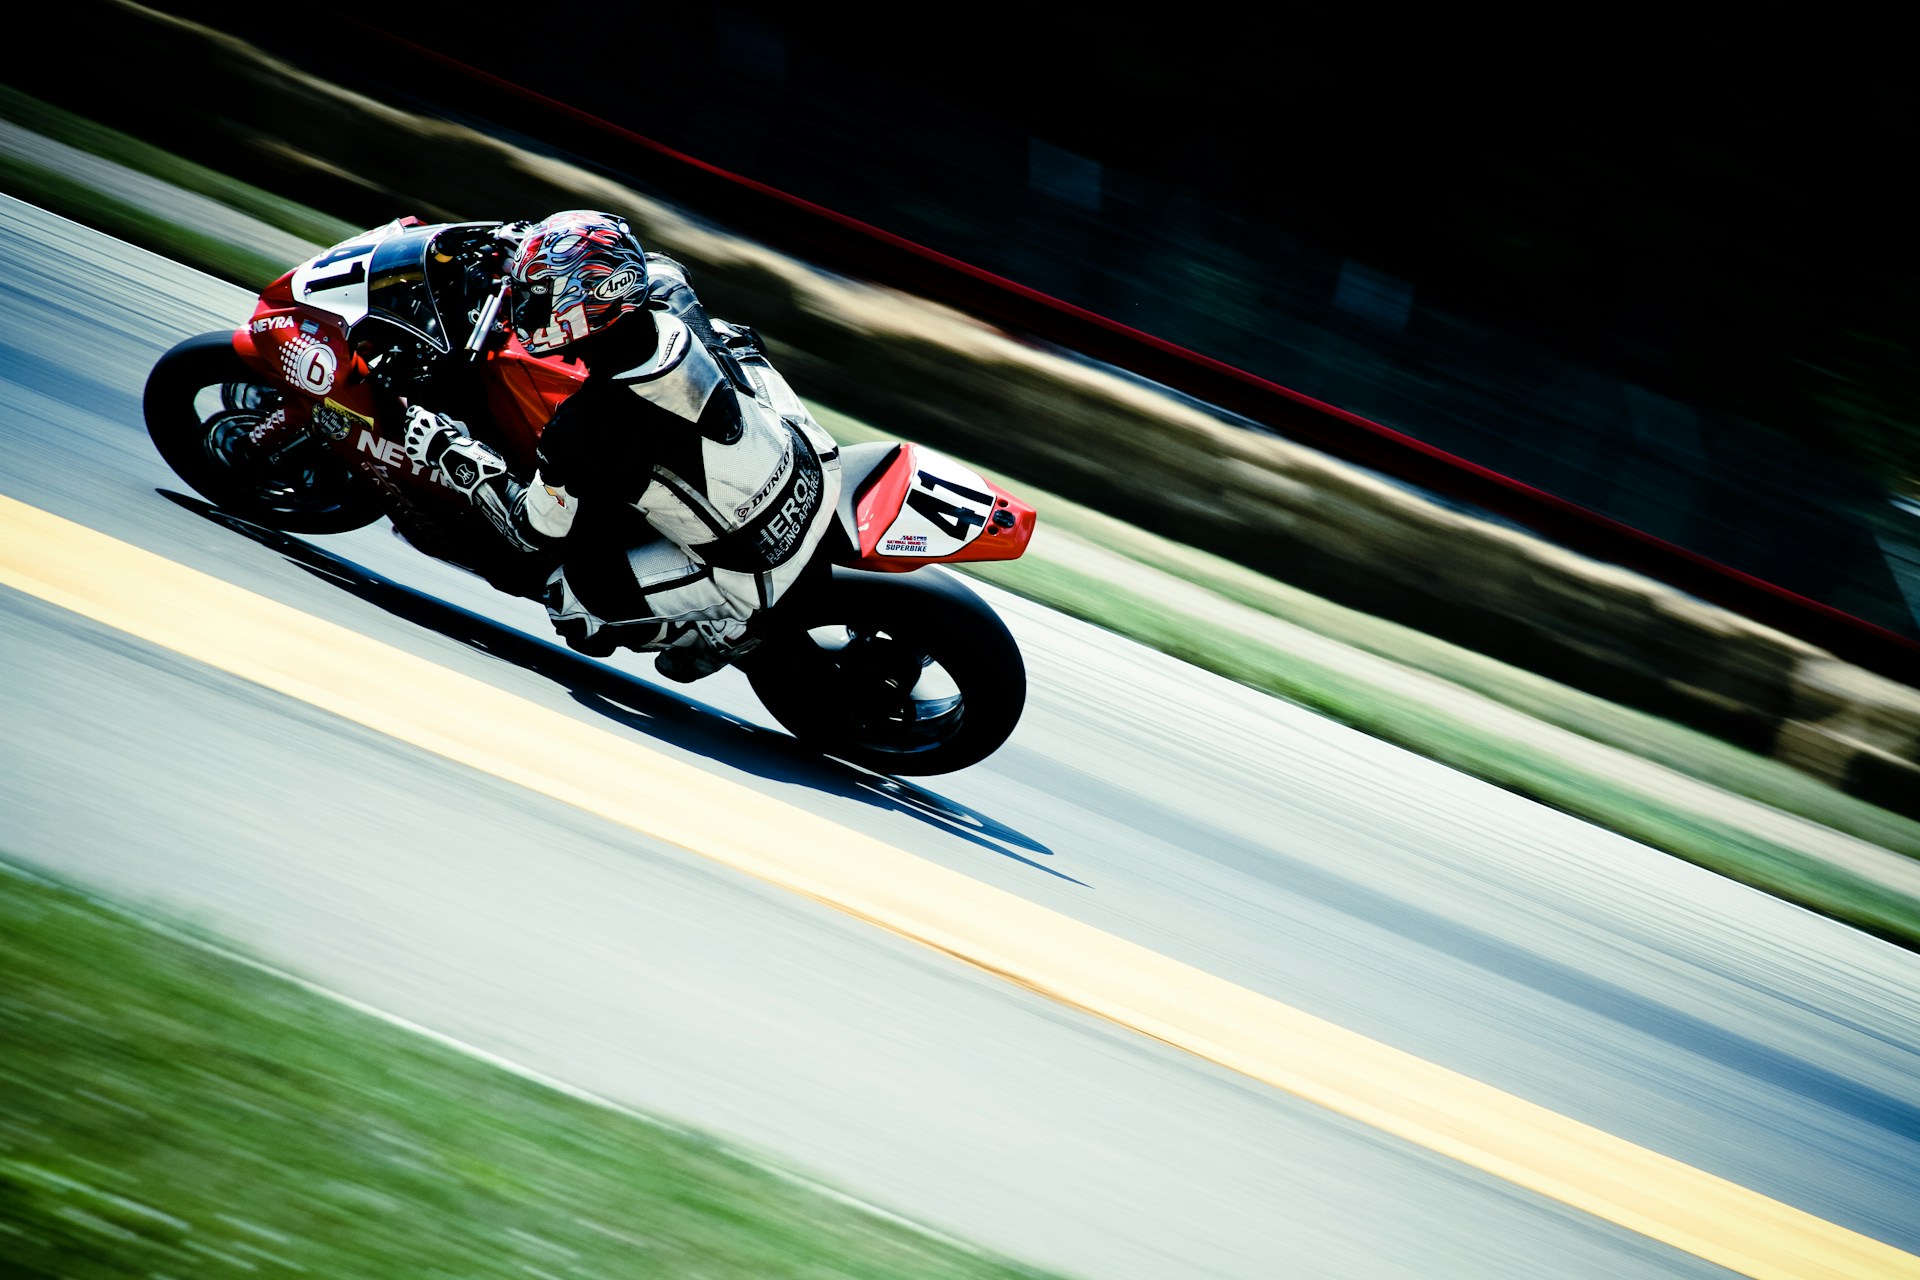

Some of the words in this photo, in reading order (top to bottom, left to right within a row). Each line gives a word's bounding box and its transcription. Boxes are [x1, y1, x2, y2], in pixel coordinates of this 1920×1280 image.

[305, 244, 377, 295] 41
[253, 316, 294, 333] NEYRA
[532, 302, 590, 348] 41
[751, 443, 791, 509] DUNLO
[906, 469, 994, 541] 41
[766, 522, 801, 565] RACING
[886, 544, 927, 552] SUPERBIKE
